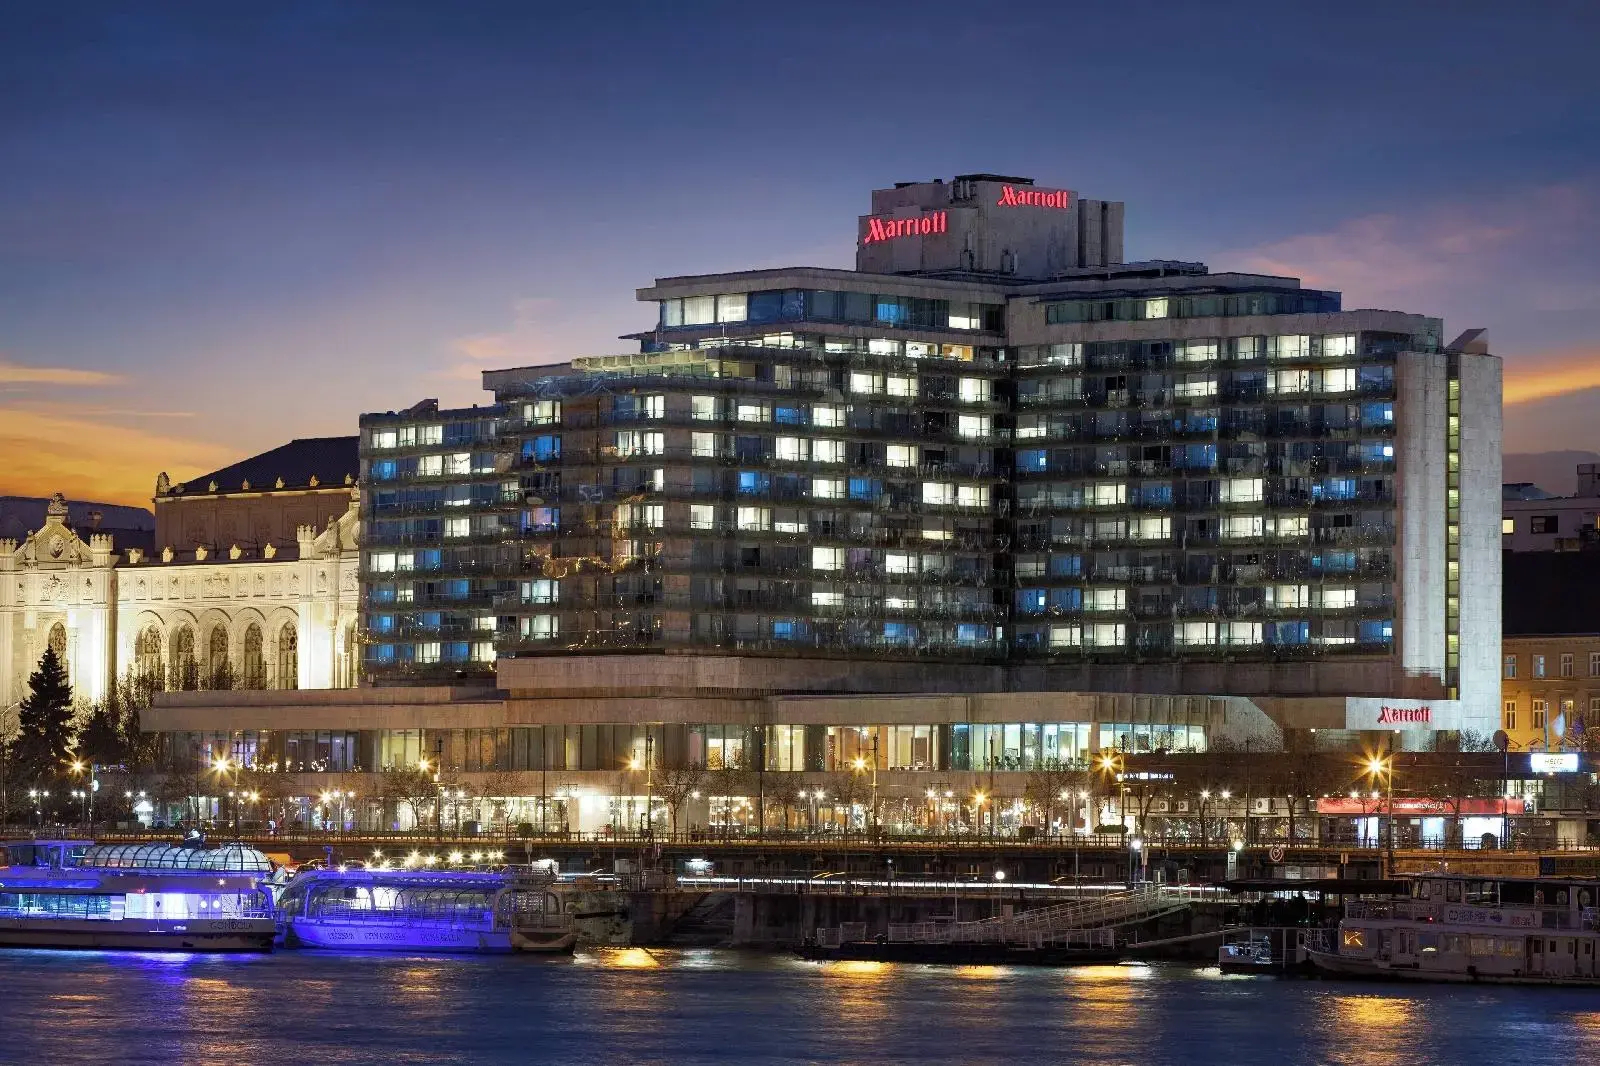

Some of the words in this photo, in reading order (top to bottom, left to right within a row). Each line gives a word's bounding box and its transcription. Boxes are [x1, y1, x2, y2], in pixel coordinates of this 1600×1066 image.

[997, 184, 1069, 209] Marriott
[864, 212, 948, 244] Marriott
[1377, 706, 1432, 724] Marriott
